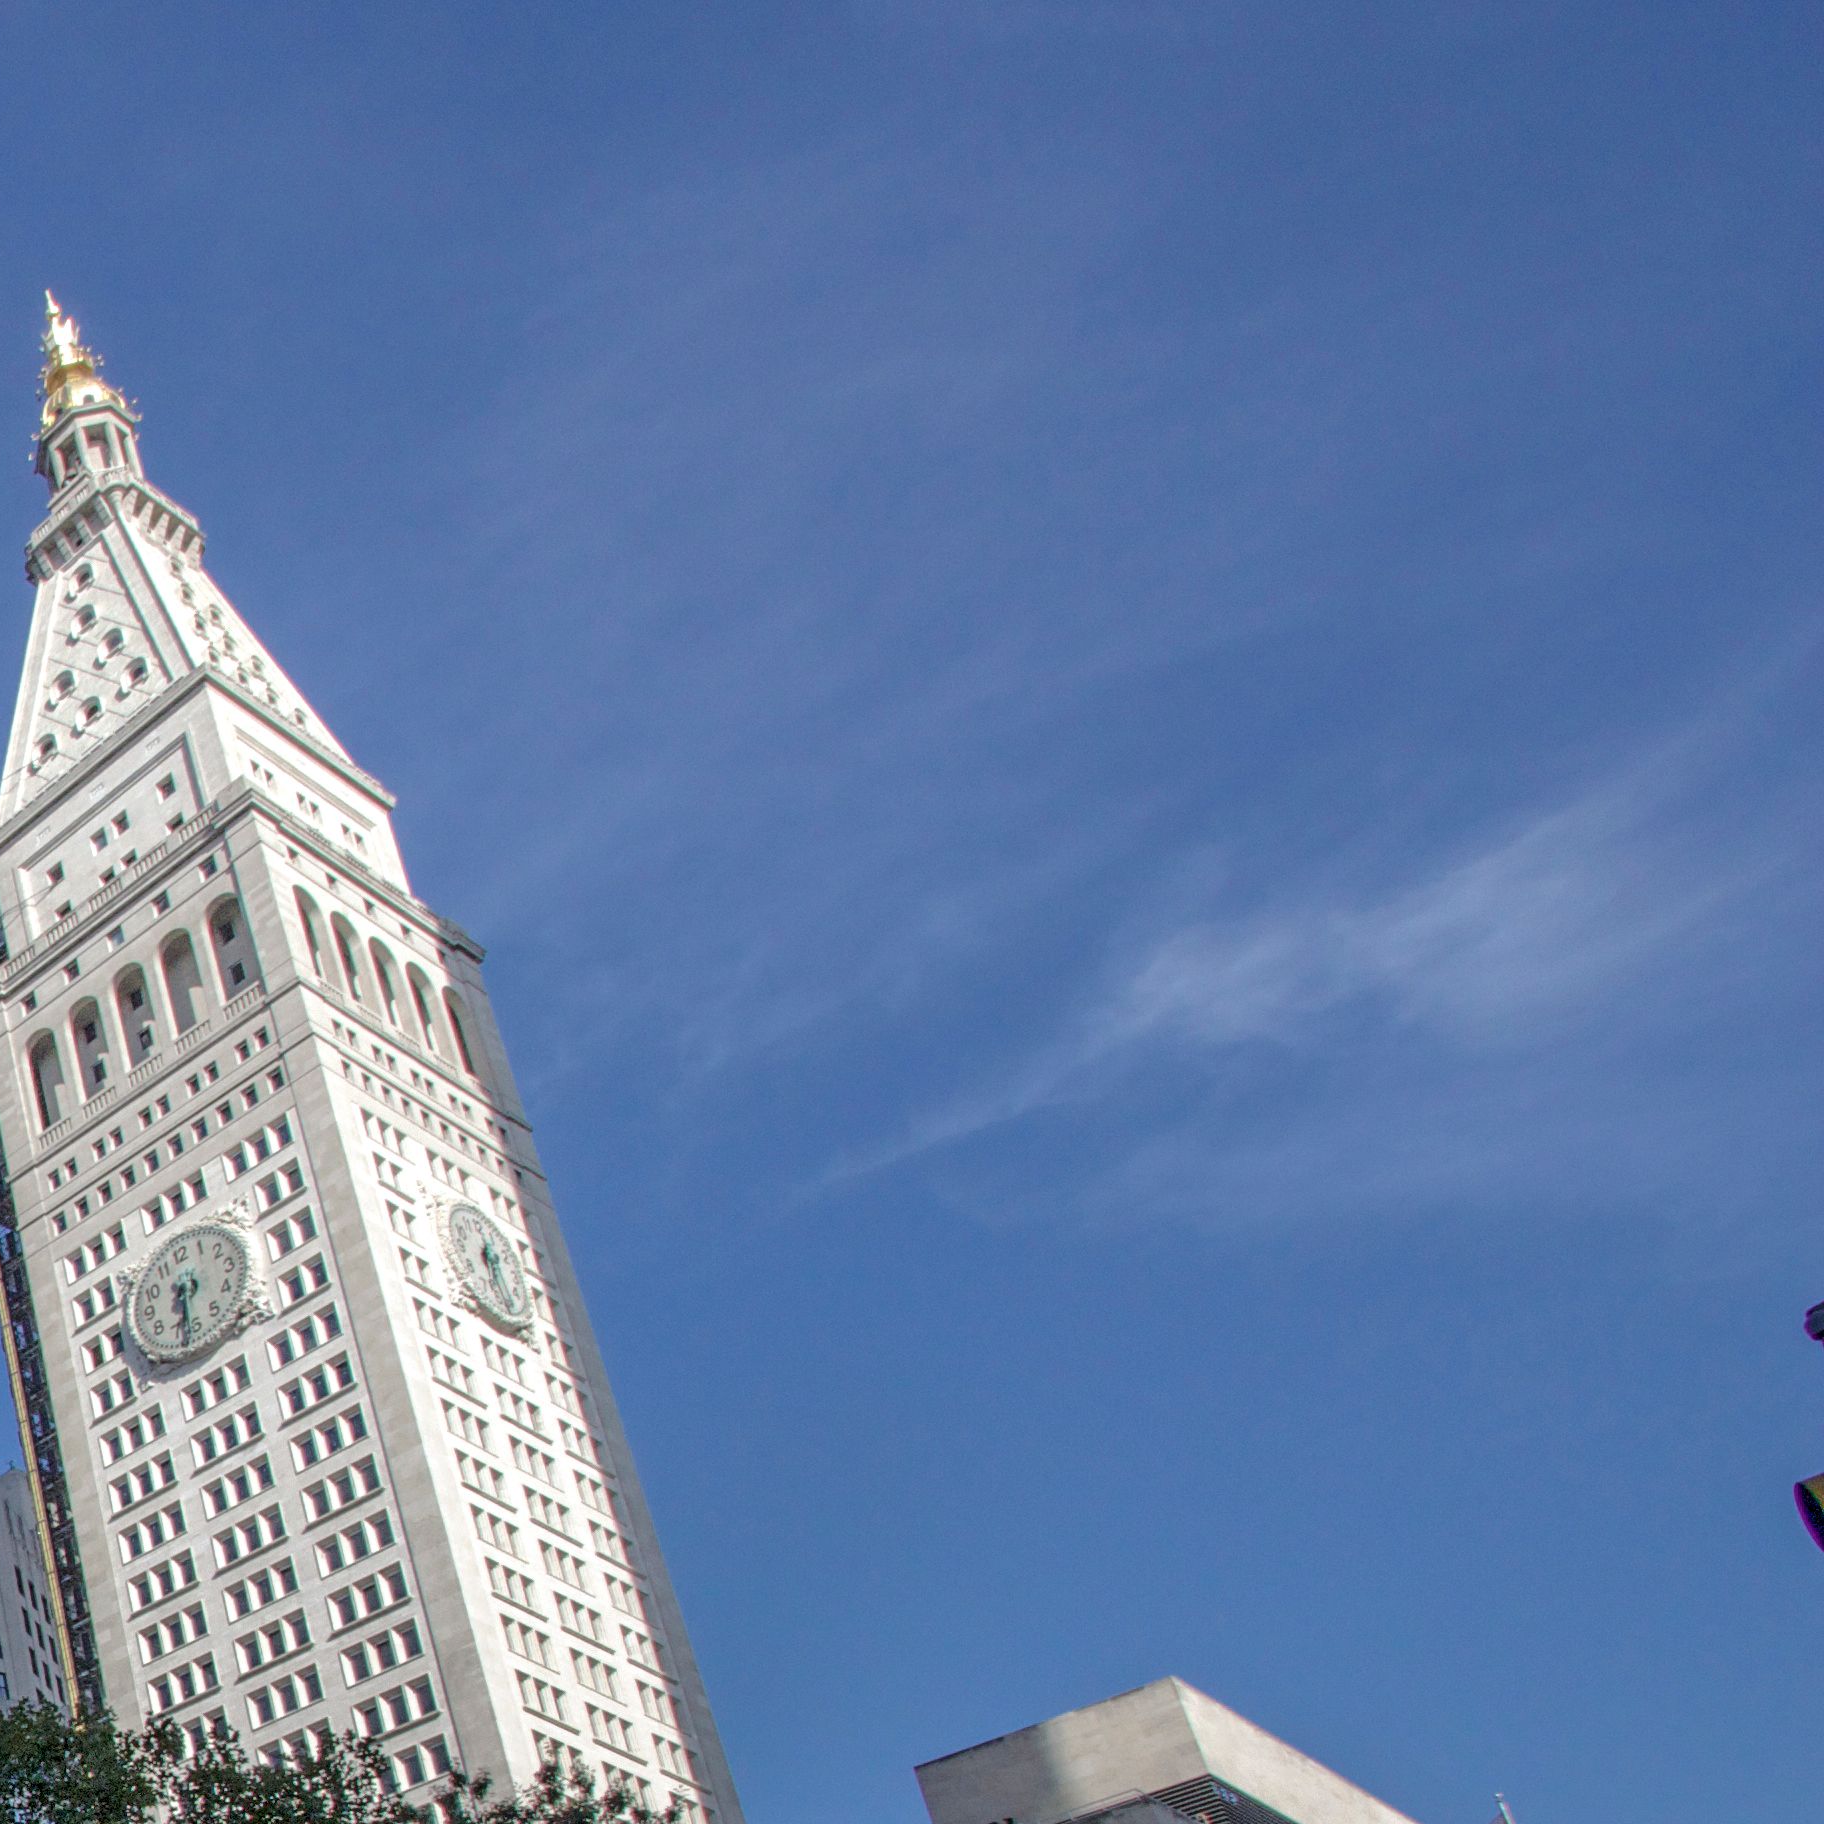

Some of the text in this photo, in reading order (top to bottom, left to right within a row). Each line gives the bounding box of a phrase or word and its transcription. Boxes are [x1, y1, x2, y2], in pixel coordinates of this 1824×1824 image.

[173, 1246, 189, 1265] 12
[196, 1240, 204, 1255] 1
[212, 1243, 223, 1259] 2
[157, 1261, 170, 1280] 11
[223, 1257, 235, 1273] 3
[145, 1284, 160, 1302] 10
[220, 1278, 231, 1293] 4
[144, 1304, 155, 1320] 9
[208, 1300, 220, 1317] 5
[153, 1319, 164, 1336] 8
[170, 1321, 182, 1339] 7
